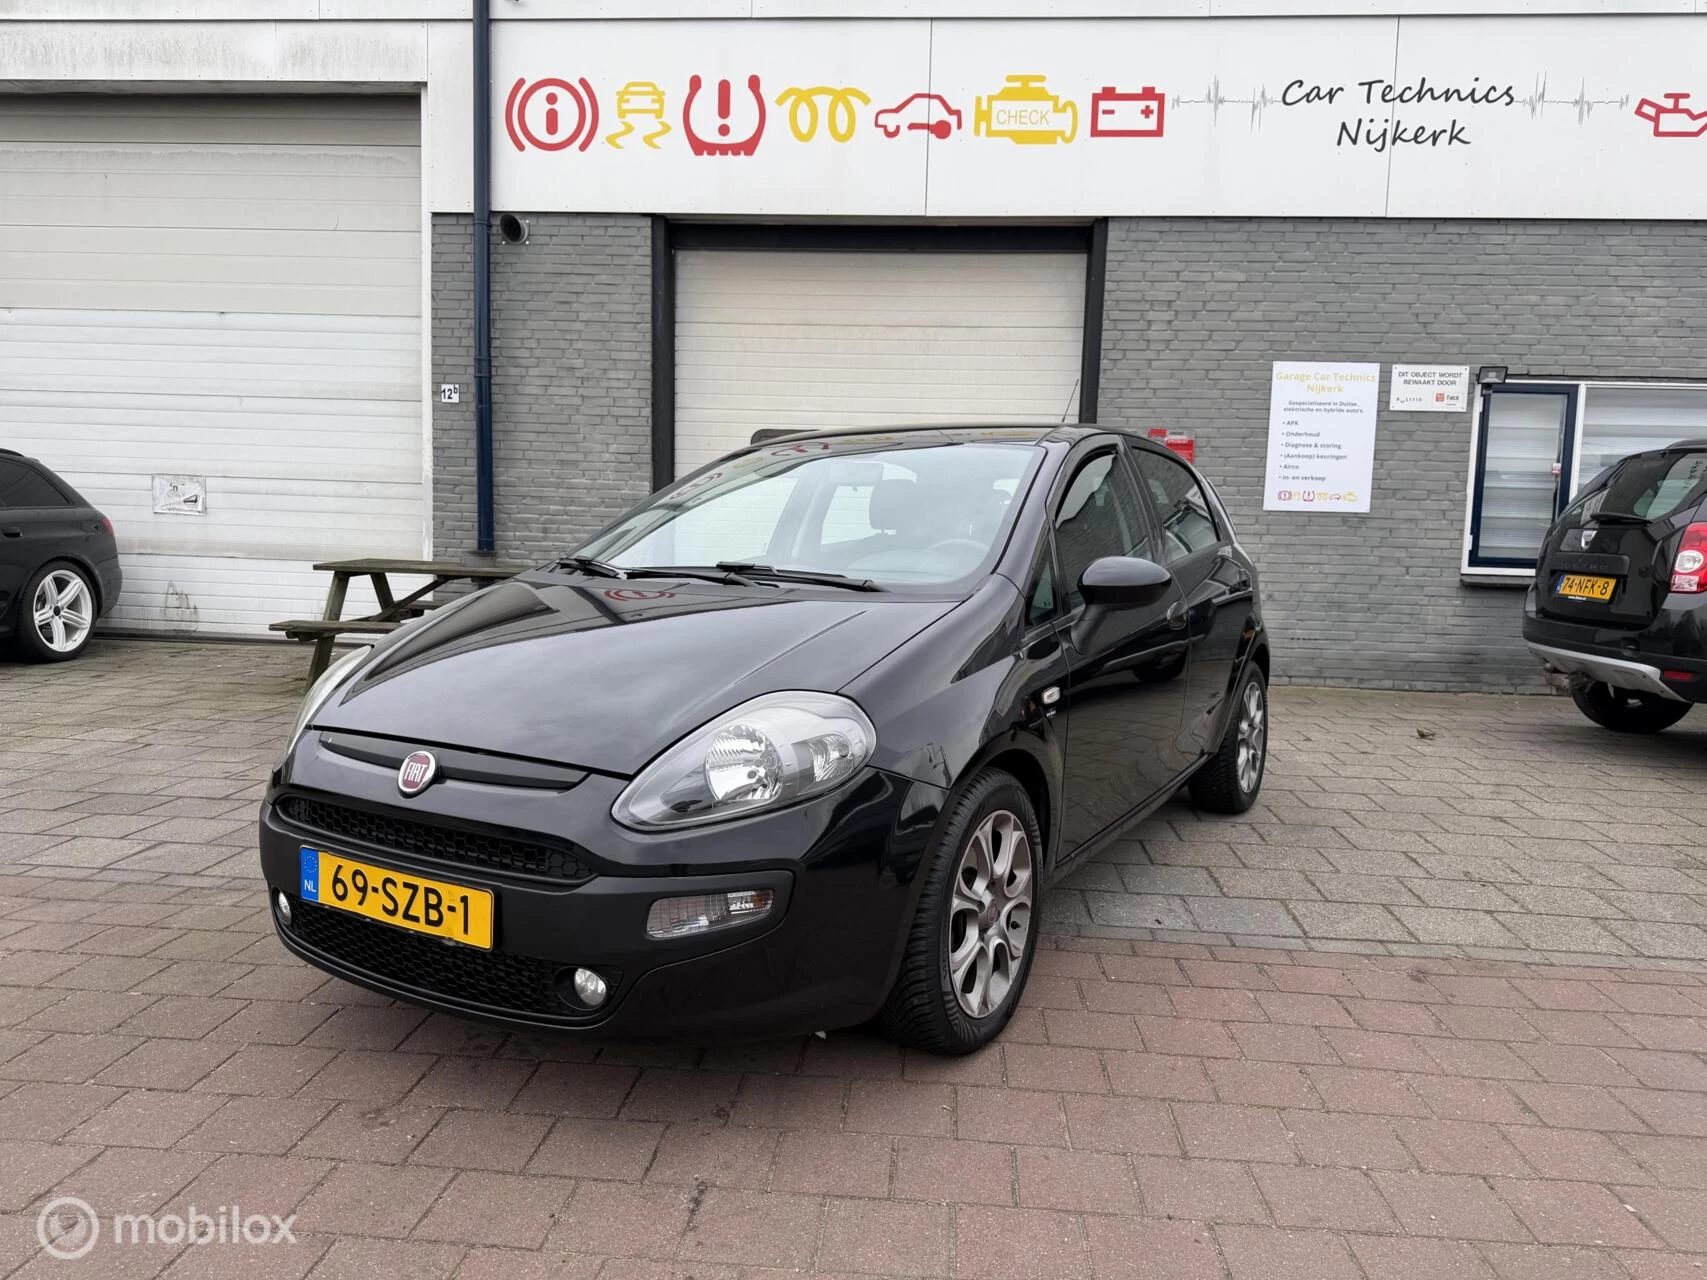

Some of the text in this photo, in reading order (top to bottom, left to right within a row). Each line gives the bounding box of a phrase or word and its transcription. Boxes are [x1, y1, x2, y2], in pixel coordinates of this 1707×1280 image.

[1281, 76, 1515, 107] Car Technics
[995, 109, 1050, 125] CHECK
[1336, 117, 1472, 153] Nijkerk
[1276, 372, 1377, 384] Garage Car Technics
[1306, 384, 1345, 394] Nijkerk
[403, 761, 429, 783] FIAT
[303, 878, 317, 894] NL
[331, 863, 469, 936] 69-SZB-1
